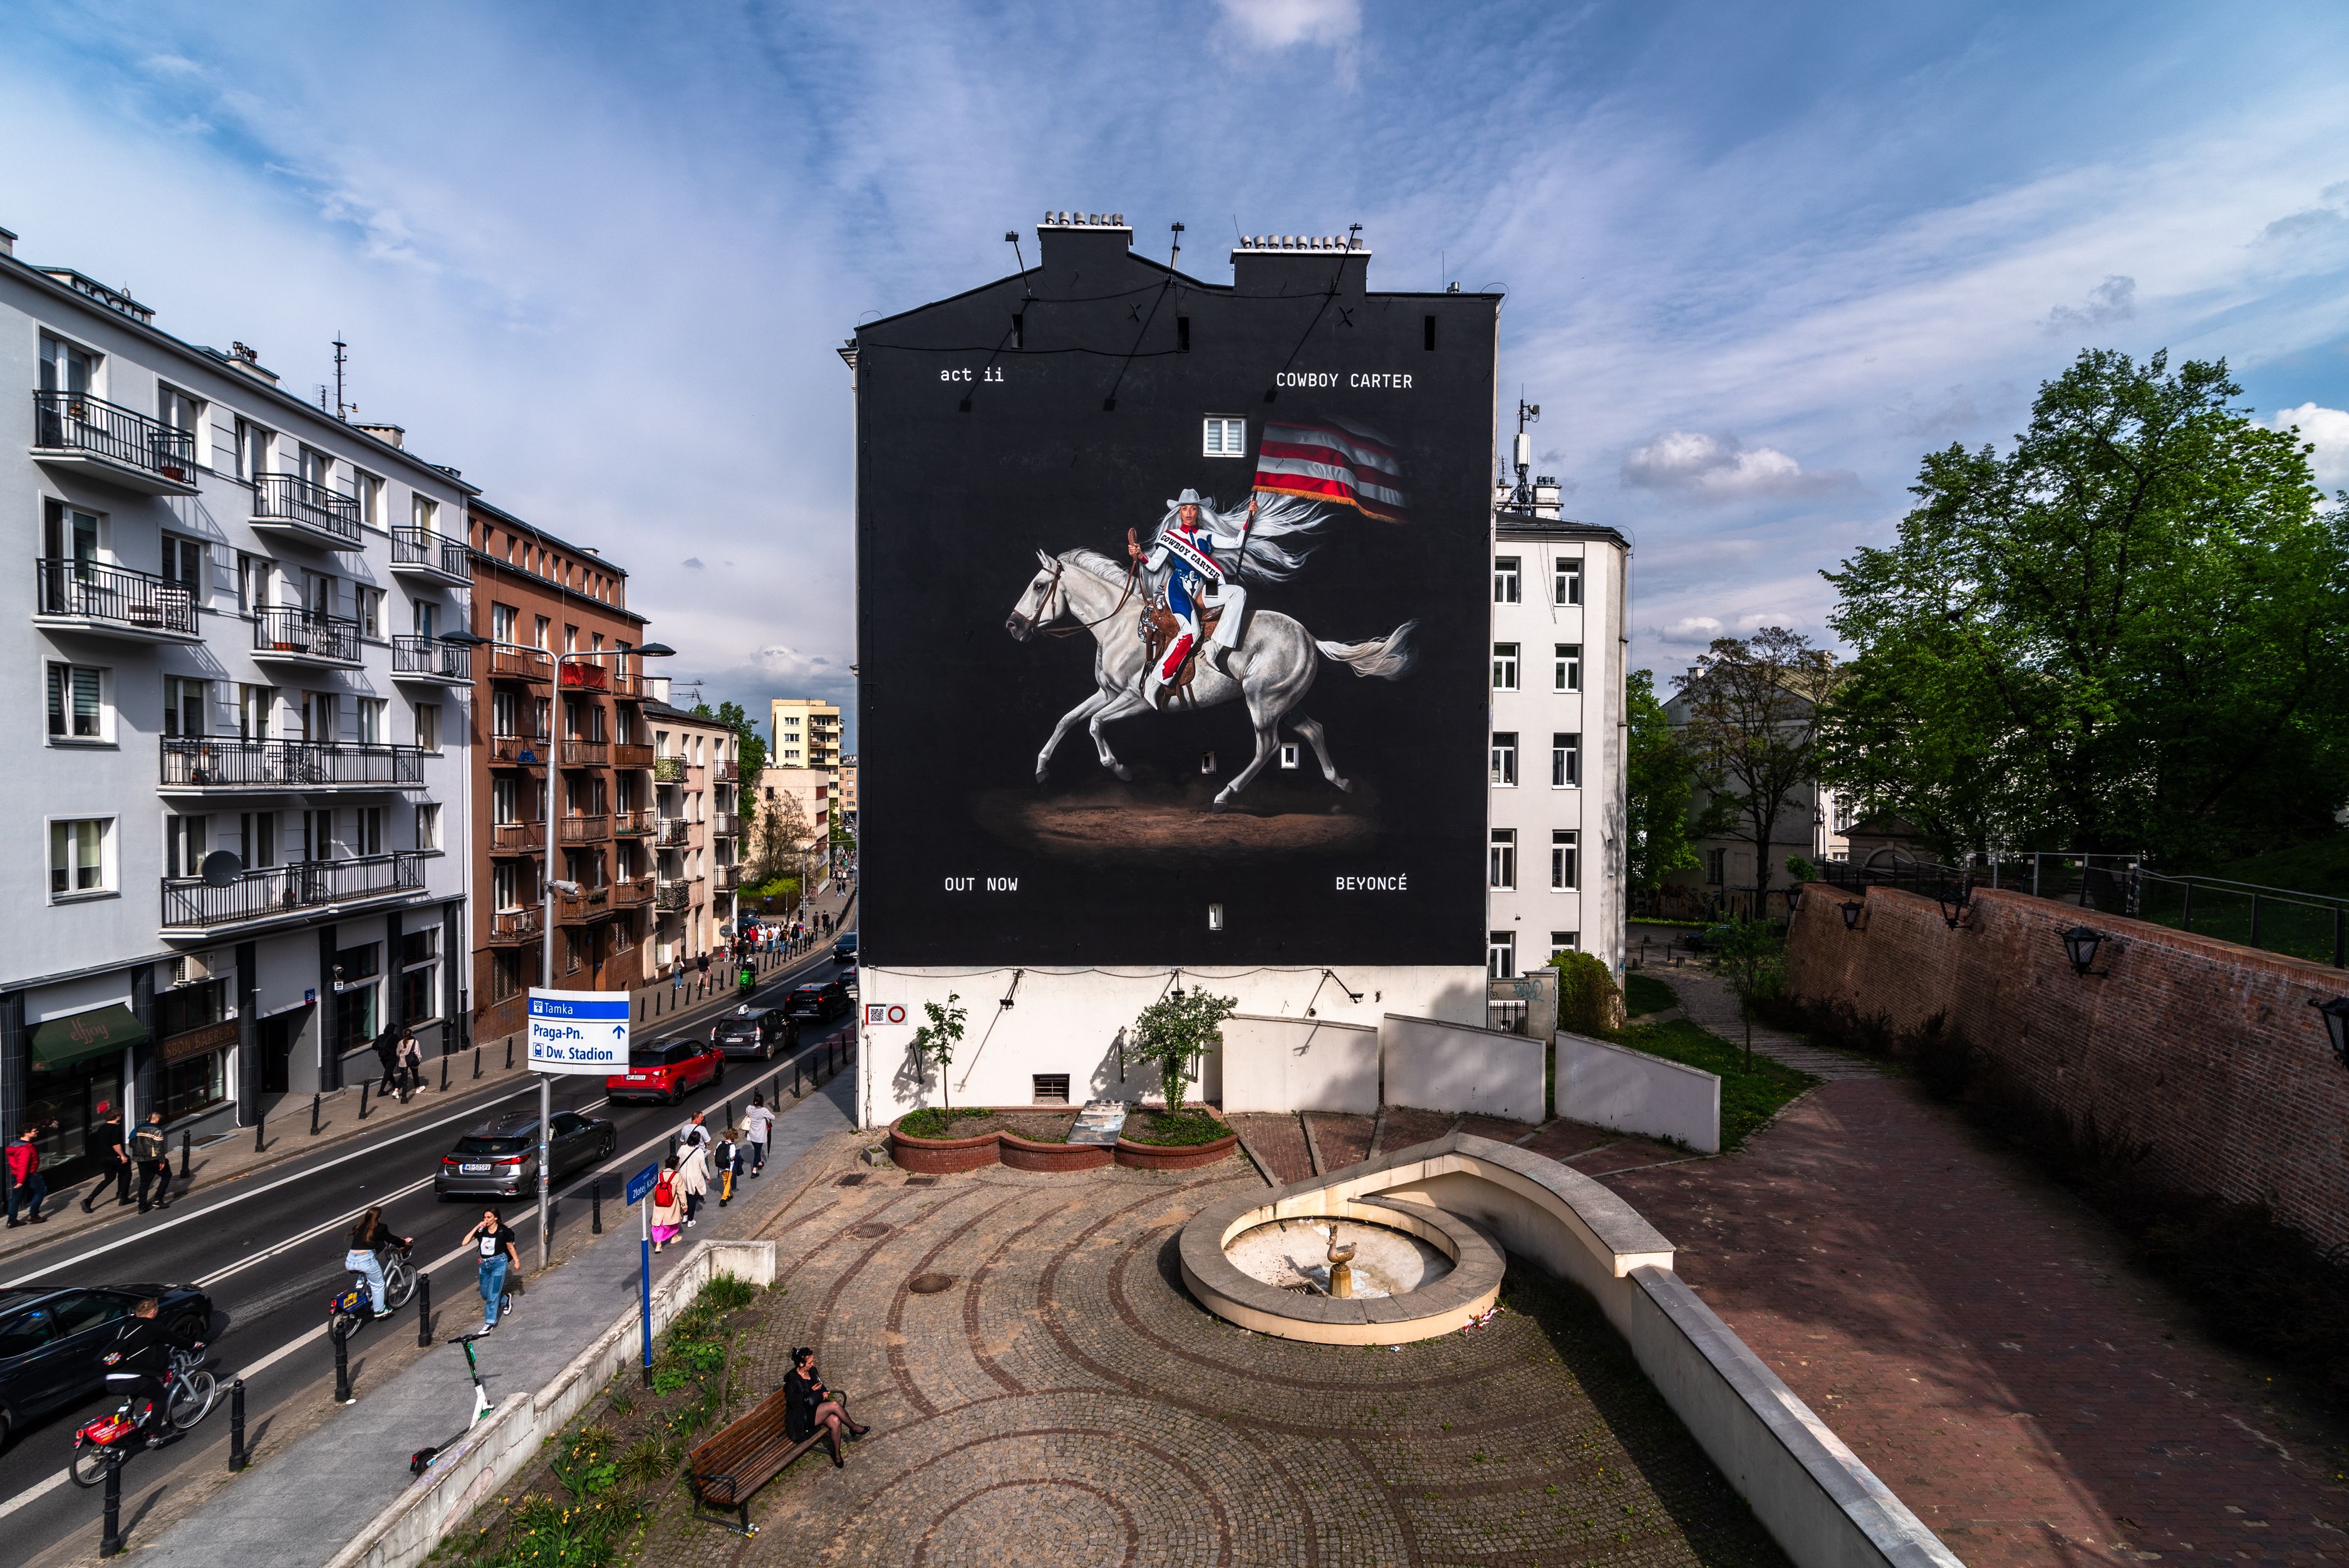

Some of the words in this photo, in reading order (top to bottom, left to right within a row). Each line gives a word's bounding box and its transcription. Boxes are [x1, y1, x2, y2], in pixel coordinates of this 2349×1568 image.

[940, 368, 972, 382] act
[984, 366, 1004, 382] ii
[1277, 372, 1339, 387] COWBOY
[1351, 373, 1413, 388] CARTER
[1160, 534, 1191, 556] COWBOY
[1190, 553, 1220, 579] CARTER
[945, 877, 975, 891] OUT
[987, 877, 1018, 891] NOW
[1336, 873, 1407, 890] BEYONCÉ
[308, 992, 314, 1001] 36
[544, 1002, 573, 1015] Tamka
[194, 1026, 235, 1049] BARBERS
[534, 1024, 584, 1041] Praga-Pn.
[775, 1032, 783, 1040] Uber
[546, 1046, 565, 1059] Dw.
[569, 1047, 613, 1060] Stadion
[633, 1183, 646, 1199] Złotej
